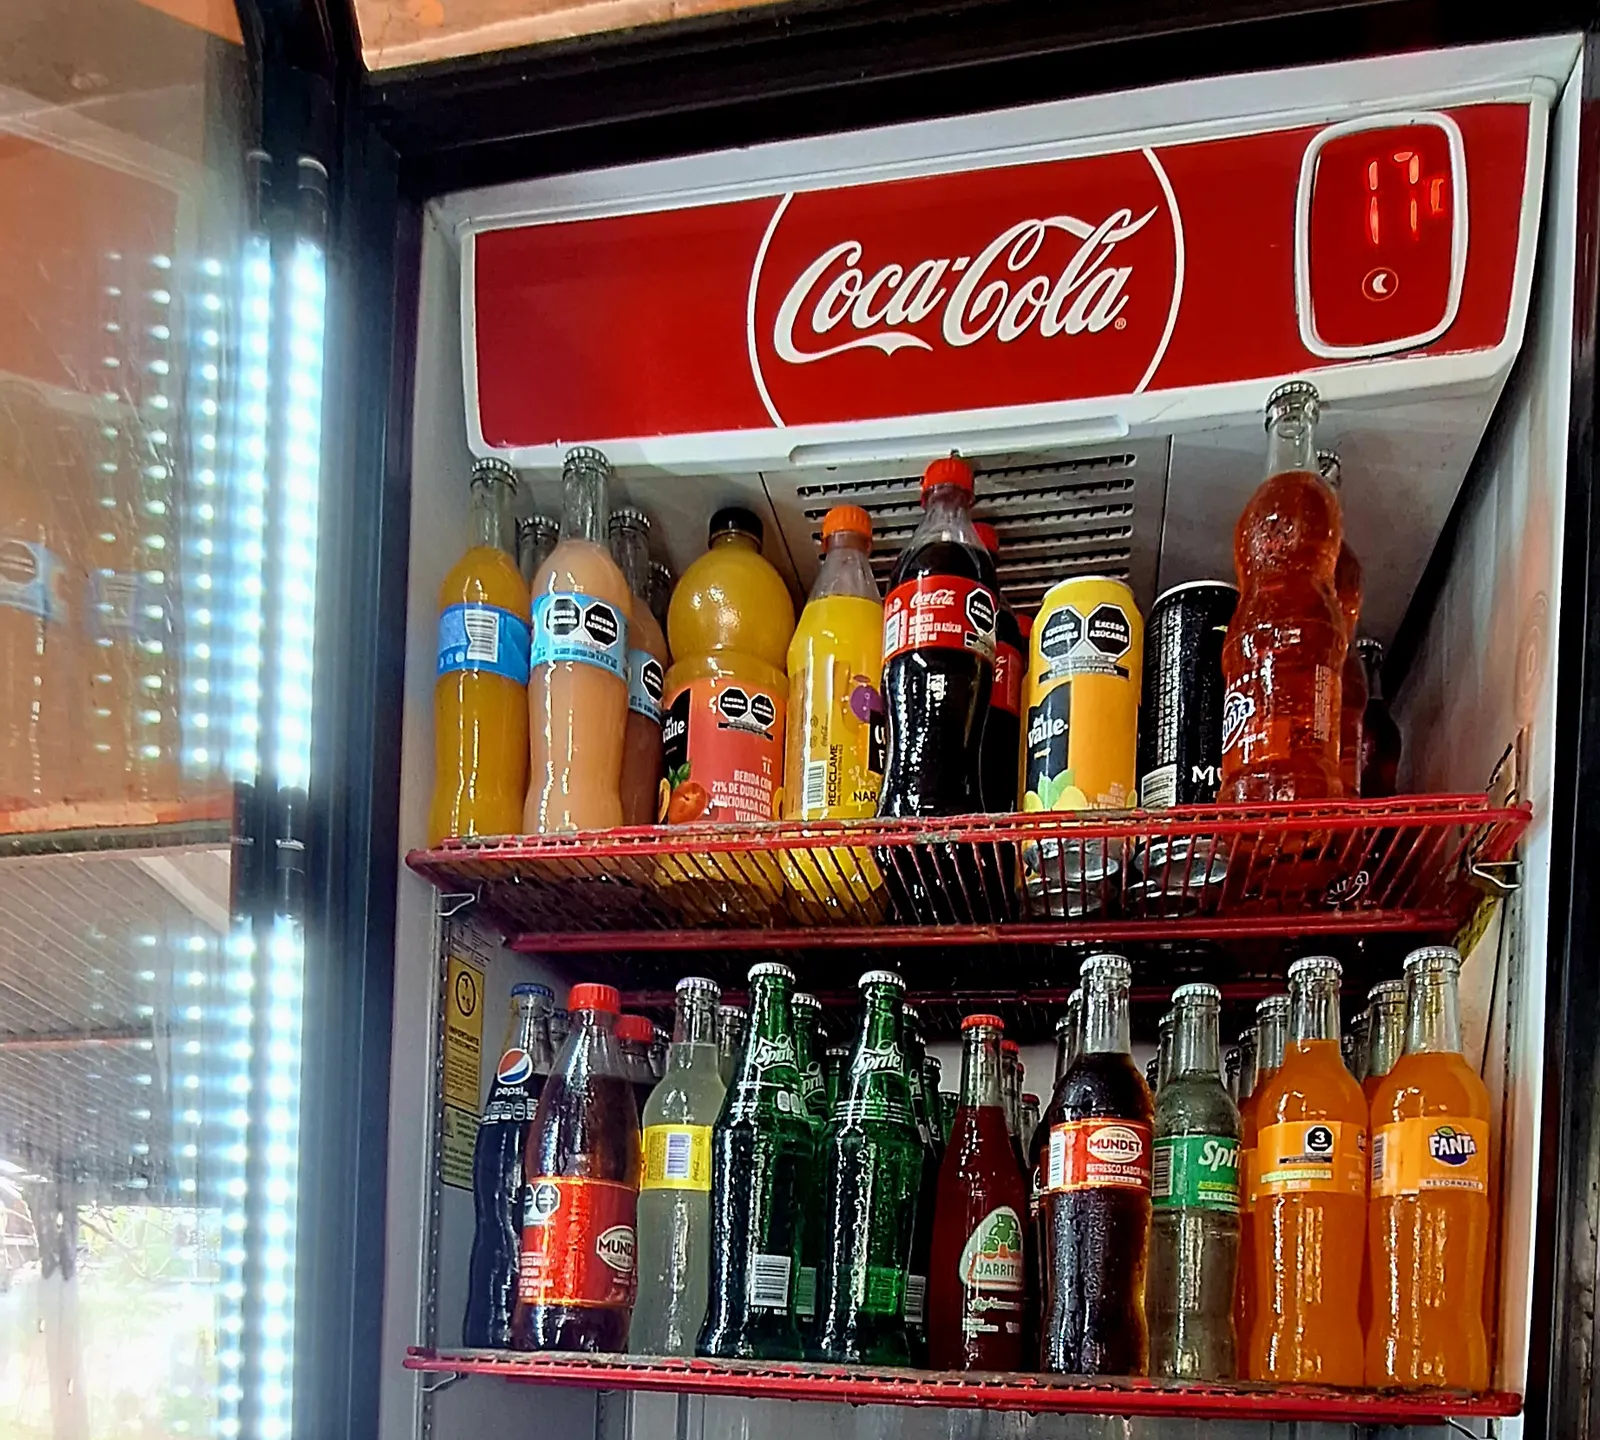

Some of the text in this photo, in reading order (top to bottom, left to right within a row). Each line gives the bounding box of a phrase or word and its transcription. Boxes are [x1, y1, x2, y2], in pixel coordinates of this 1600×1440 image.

[773, 204, 1158, 364] Coca-Cola
[910, 588, 956, 609] Coca-Cola
[1045, 622, 1076, 638] EXCESO
[1094, 620, 1126, 634] EXCESO
[734, 769, 773, 791] BEBIDA CON
[728, 784, 738, 793] DE
[756, 1044, 795, 1065] Sprite
[857, 1052, 901, 1074] Sprite
[494, 1085, 524, 1098] pepsi
[1314, 1131, 1326, 1143] 3
[1088, 1139, 1141, 1153] MUNDET
[1429, 1134, 1476, 1157] FANTA
[1086, 1164, 1122, 1175] REFRESCO
[1425, 1179, 1481, 1190] RETORNABLE
